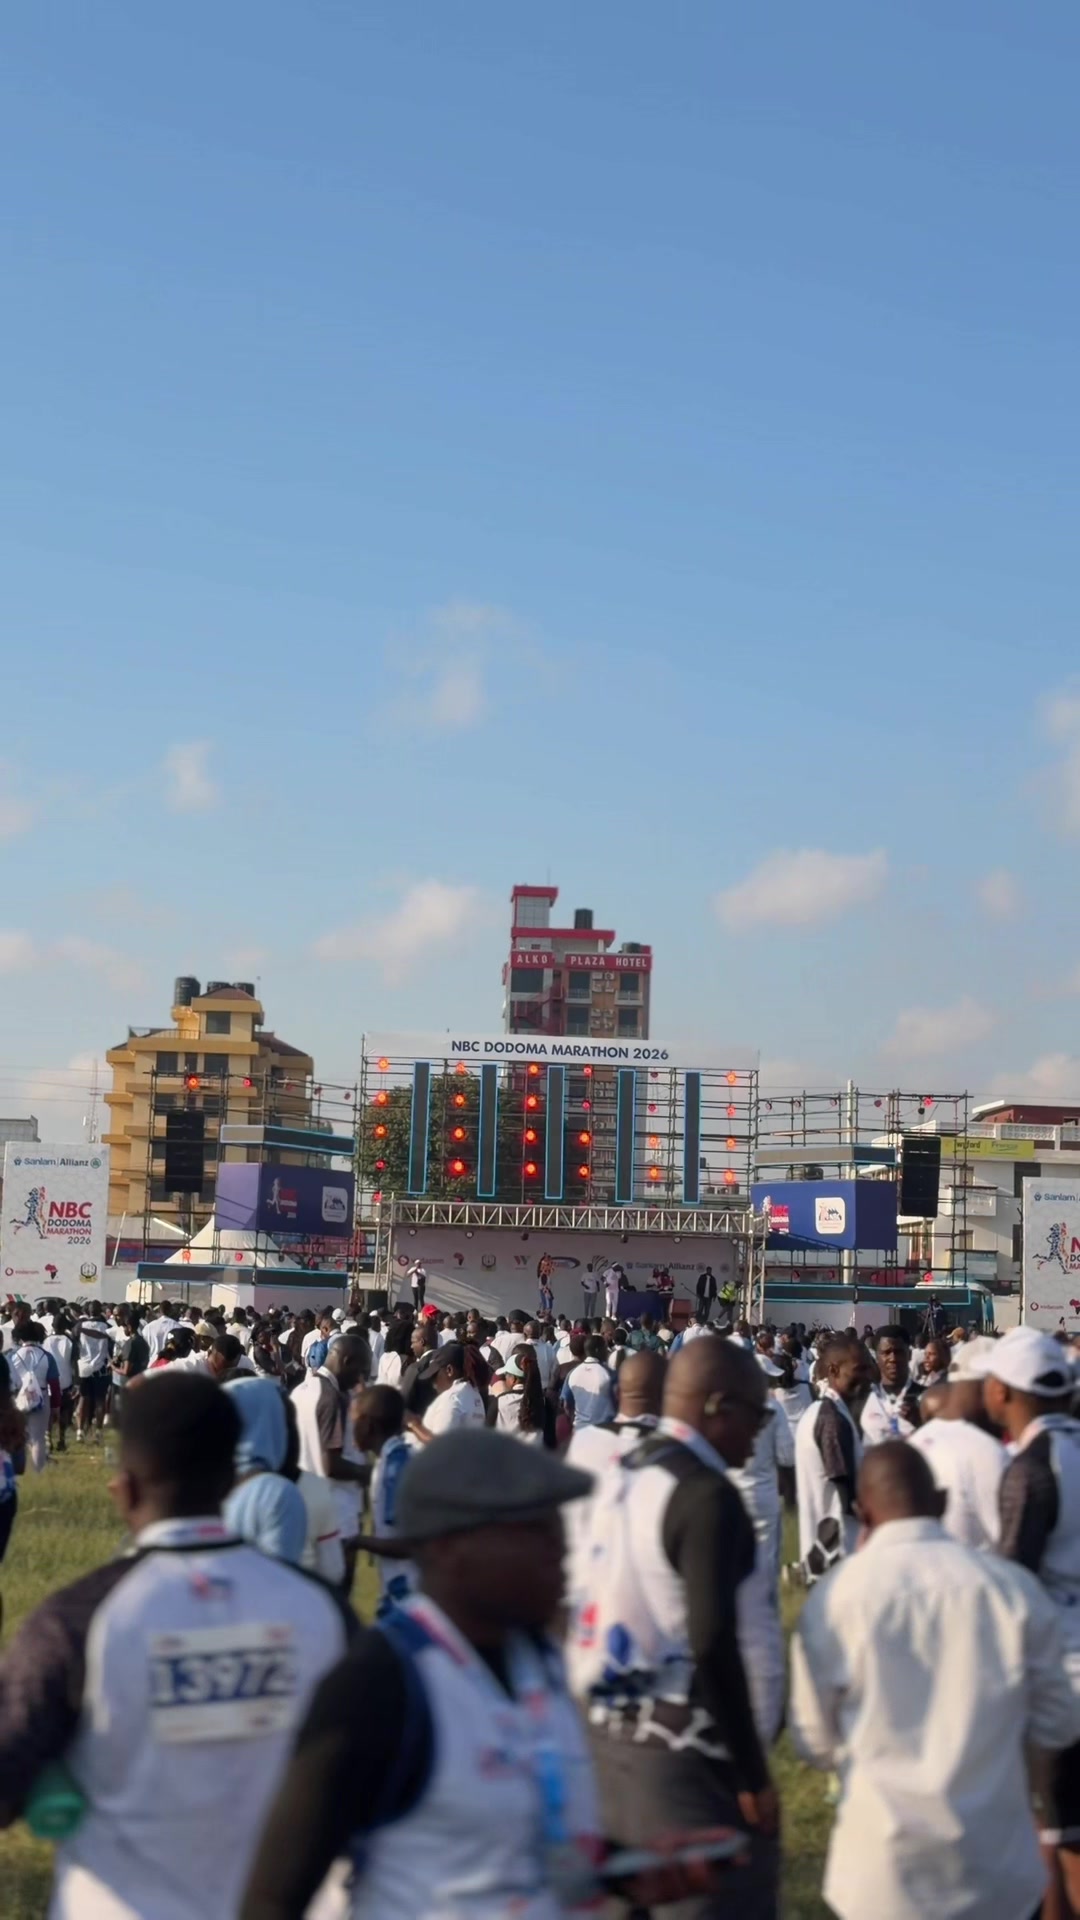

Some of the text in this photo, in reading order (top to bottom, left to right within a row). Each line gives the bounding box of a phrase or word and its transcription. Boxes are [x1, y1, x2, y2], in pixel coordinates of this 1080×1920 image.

[516, 954, 647, 968] ALKO PLAZA HOTEL
[451, 1040, 669, 1060] NBC DODOMA MARATHON 2026
[24, 1157, 89, 1167] Sanlam Allianz
[48, 1201, 93, 1219] NBC
[47, 1219, 92, 1228] DODOMA
[46, 1227, 92, 1235] MARATHON
[67, 1236, 91, 1245] 2026
